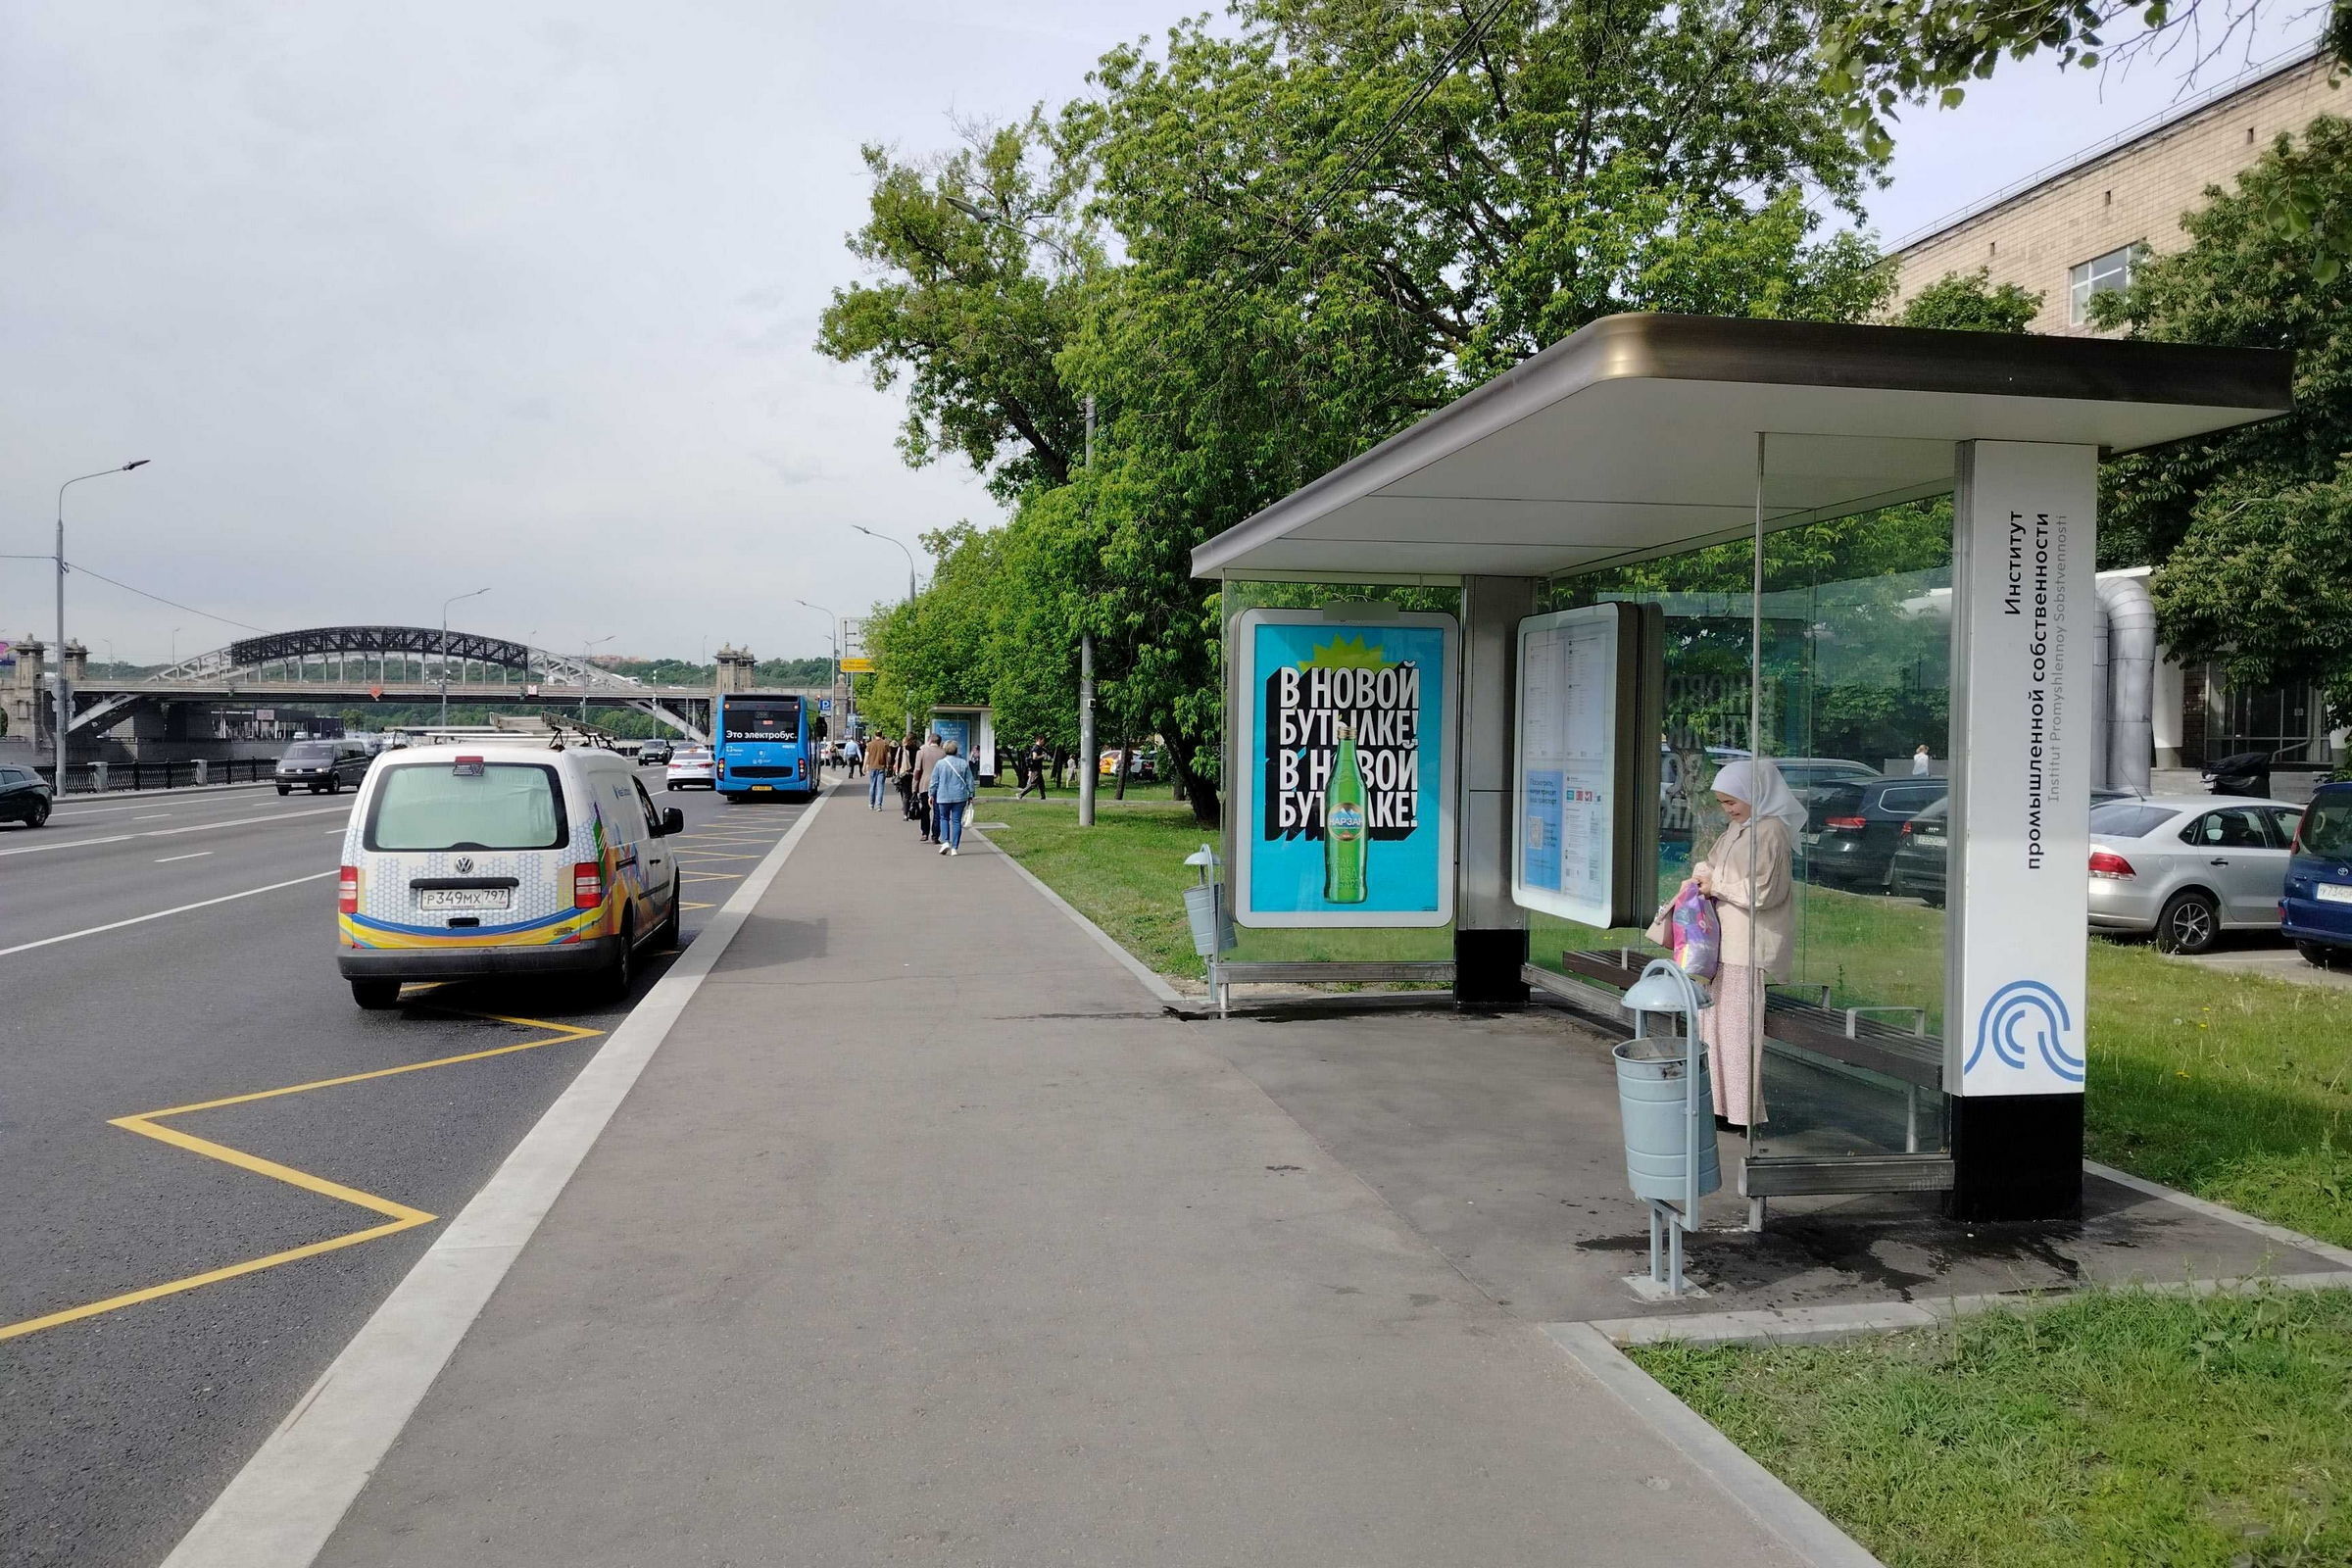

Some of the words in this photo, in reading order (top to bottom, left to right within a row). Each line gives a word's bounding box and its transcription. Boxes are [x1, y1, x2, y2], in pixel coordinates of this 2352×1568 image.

[2004, 512, 2026, 615] Институт
[2053, 514, 2067, 621] Sobstvennosti
[2030, 513, 2050, 683] собственности
[1280, 666, 1300, 709] В
[1311, 661, 1420, 709] НОВОЙ
[2050, 626, 2067, 741] Promyshlennoy
[745, 730, 797, 740] электробус.
[1280, 709, 1419, 746] БУТЫЛКЕ!
[1279, 749, 1300, 790] В
[1309, 741, 1419, 791] НВОЙ
[2028, 689, 2047, 870] промышленной
[2047, 745, 2060, 803] Institut
[484, 890, 505, 901] 797
